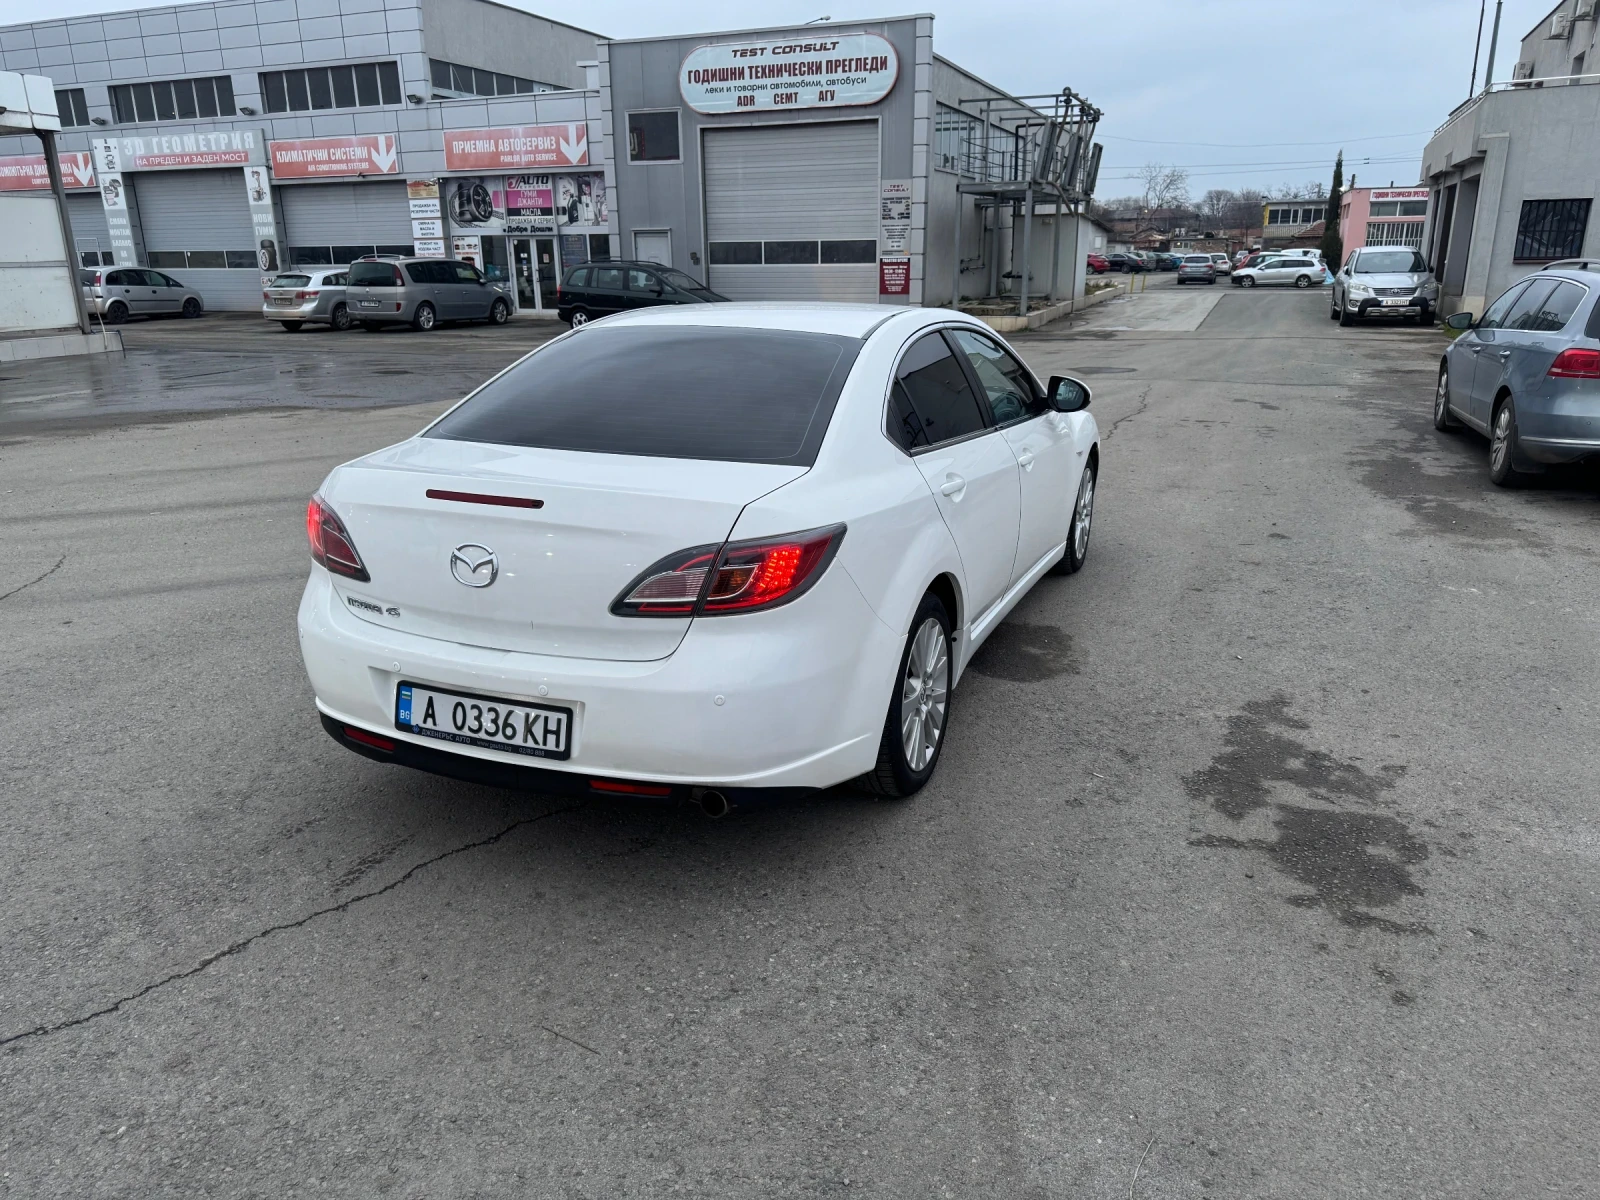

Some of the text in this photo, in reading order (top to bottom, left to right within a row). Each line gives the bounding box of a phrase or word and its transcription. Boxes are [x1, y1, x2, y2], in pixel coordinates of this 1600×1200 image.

[732, 41, 839, 58] TEST CONSULT
[687, 55, 888, 85] ГОДИШНИ ТЕХНИЧЕСКИ ПРЕГЛЕДИ
[704, 86, 725, 94] леки
[733, 83, 768, 94] товарни
[769, 79, 824, 90] автомобили,
[825, 76, 867, 87] автобуси
[737, 95, 755, 107] ADR
[818, 89, 836, 102] АГУ
[123, 132, 255, 155] 3D ГЕОМЕТРИЯ
[452, 136, 557, 154] ПРИЕМНА АВТОСЕРВИЗ
[136, 158, 148, 166] НА
[150, 156, 181, 165] ПРЕДЕН
[191, 155, 220, 164] ЗАДЕН
[221, 153, 246, 161] МОСТ
[276, 146, 369, 163] КЛИМАТИЧНИ СИСТЕМИ
[535, 153, 557, 161] SERVICE
[519, 175, 549, 185] AUTO
[520, 190, 537, 198] ГУМИ
[517, 198, 543, 207] ДЖАНТИ
[520, 208, 542, 216] МАСЛА
[253, 214, 273, 223] НОВИ
[255, 226, 274, 236] ГУМИ
[507, 225, 553, 233] Добре Дошли
[400, 710, 410, 720] BG
[422, 695, 562, 749] A 0336 KH
